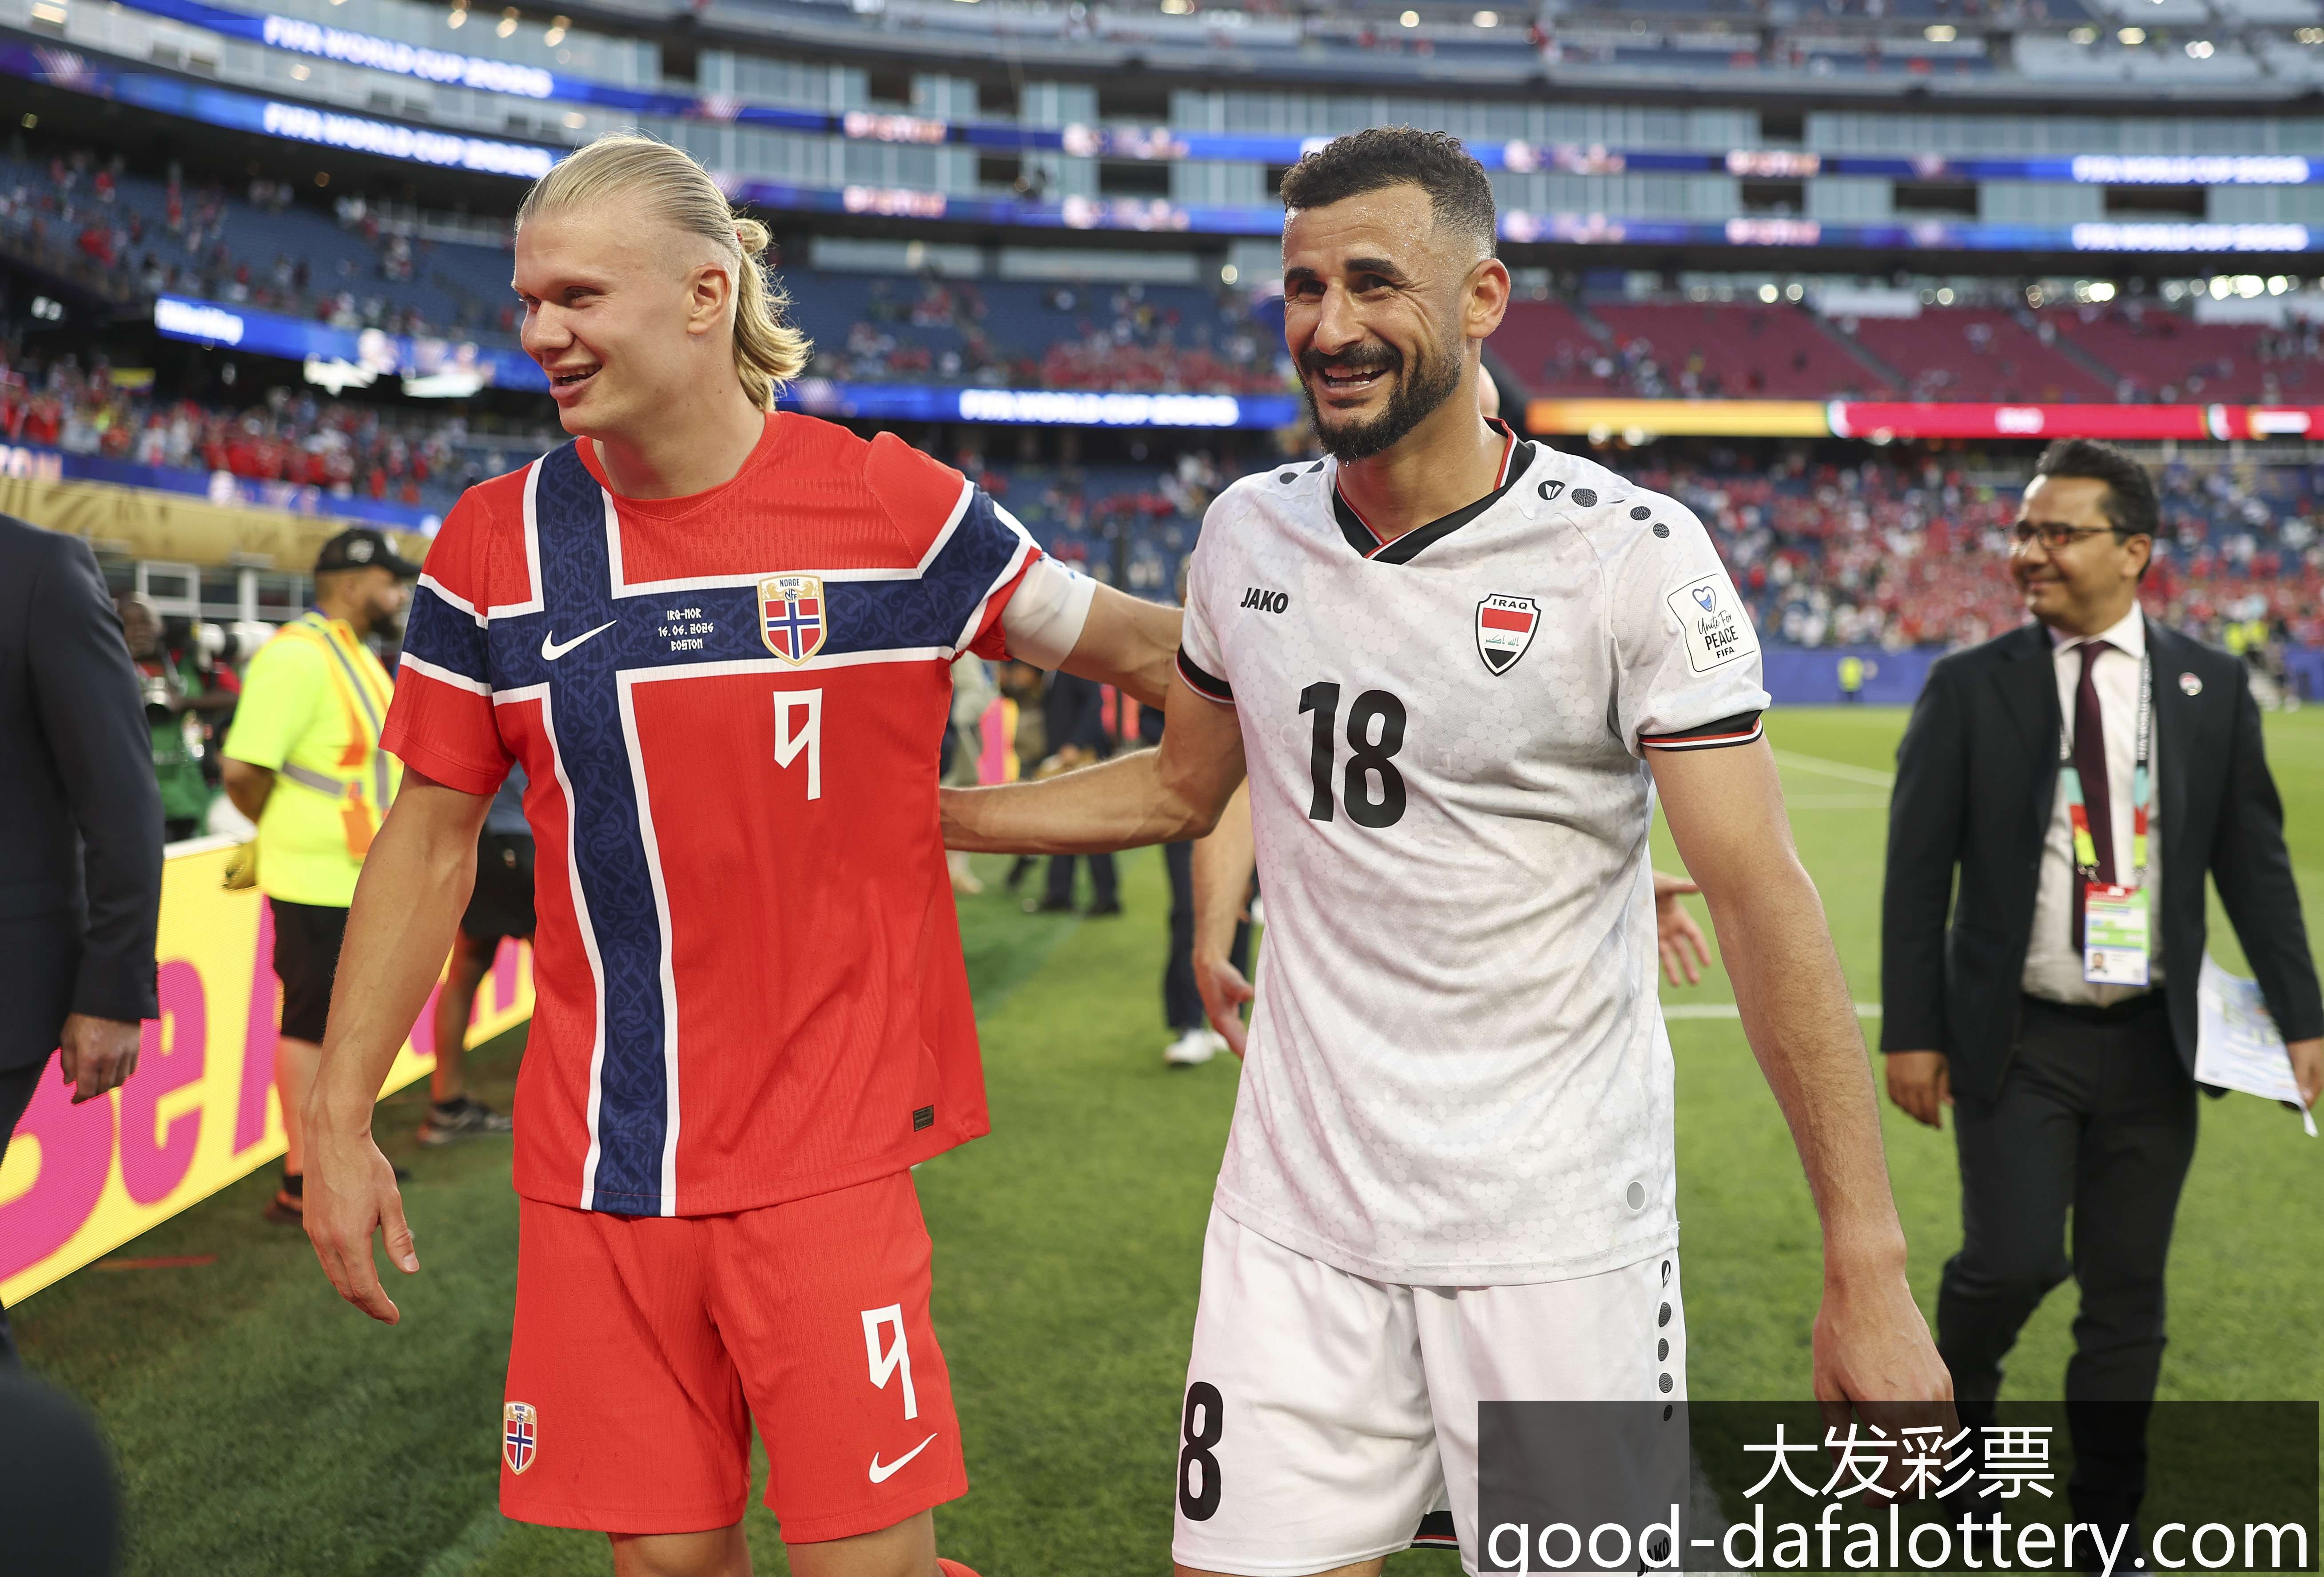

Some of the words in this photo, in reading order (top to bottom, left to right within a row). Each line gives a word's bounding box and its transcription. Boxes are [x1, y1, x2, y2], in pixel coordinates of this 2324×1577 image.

[1241, 588, 1289, 614] JAKO
[1493, 599, 1528, 610] IRAQ
[667, 608, 701, 621] IRQ-NOR
[1698, 616, 1719, 635] Unite
[1719, 610, 1732, 626] For
[671, 638, 703, 651] BOSTON
[1705, 625, 1739, 650] PEACE
[1716, 647, 1735, 658] FIFA
[773, 688, 822, 800] 9
[1298, 681, 1407, 828] 18
[860, 1303, 918, 1420] 9
